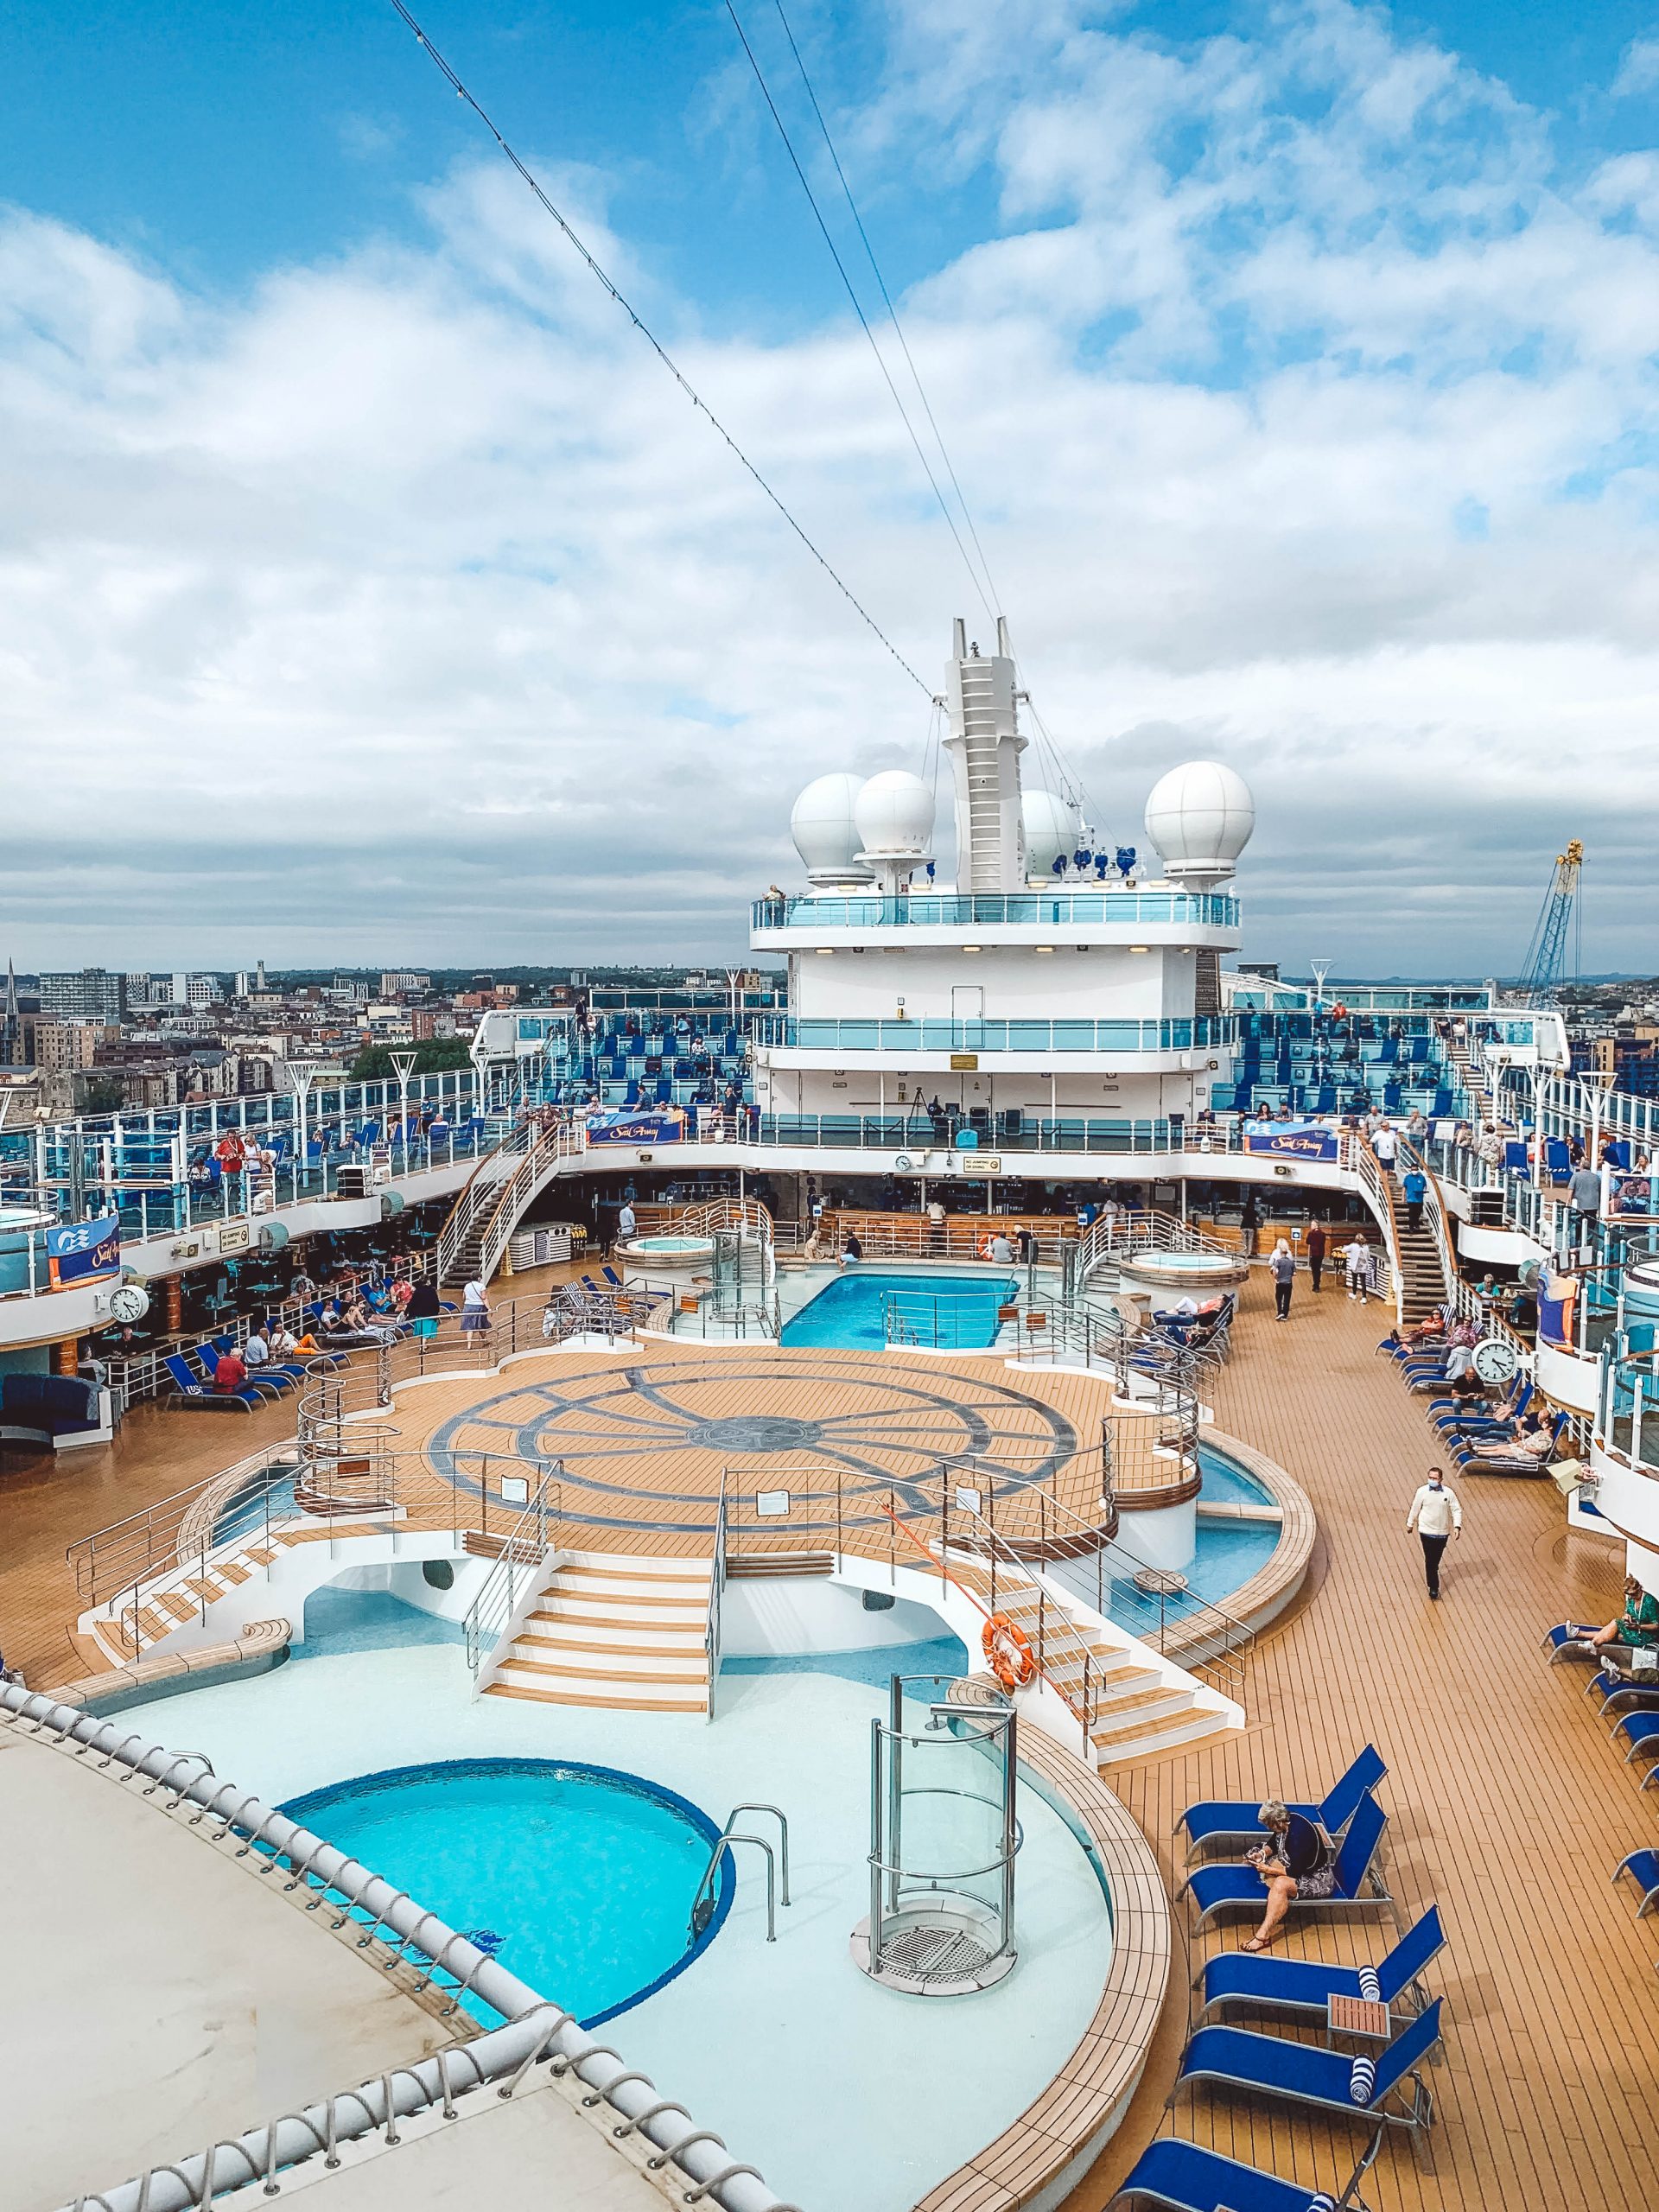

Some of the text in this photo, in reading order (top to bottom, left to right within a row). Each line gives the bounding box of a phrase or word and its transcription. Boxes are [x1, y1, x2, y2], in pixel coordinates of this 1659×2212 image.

[610, 1126, 658, 1144] Sail Away
[1271, 1136, 1322, 1158] Sail Away
[92, 1244, 113, 1268] Sail
